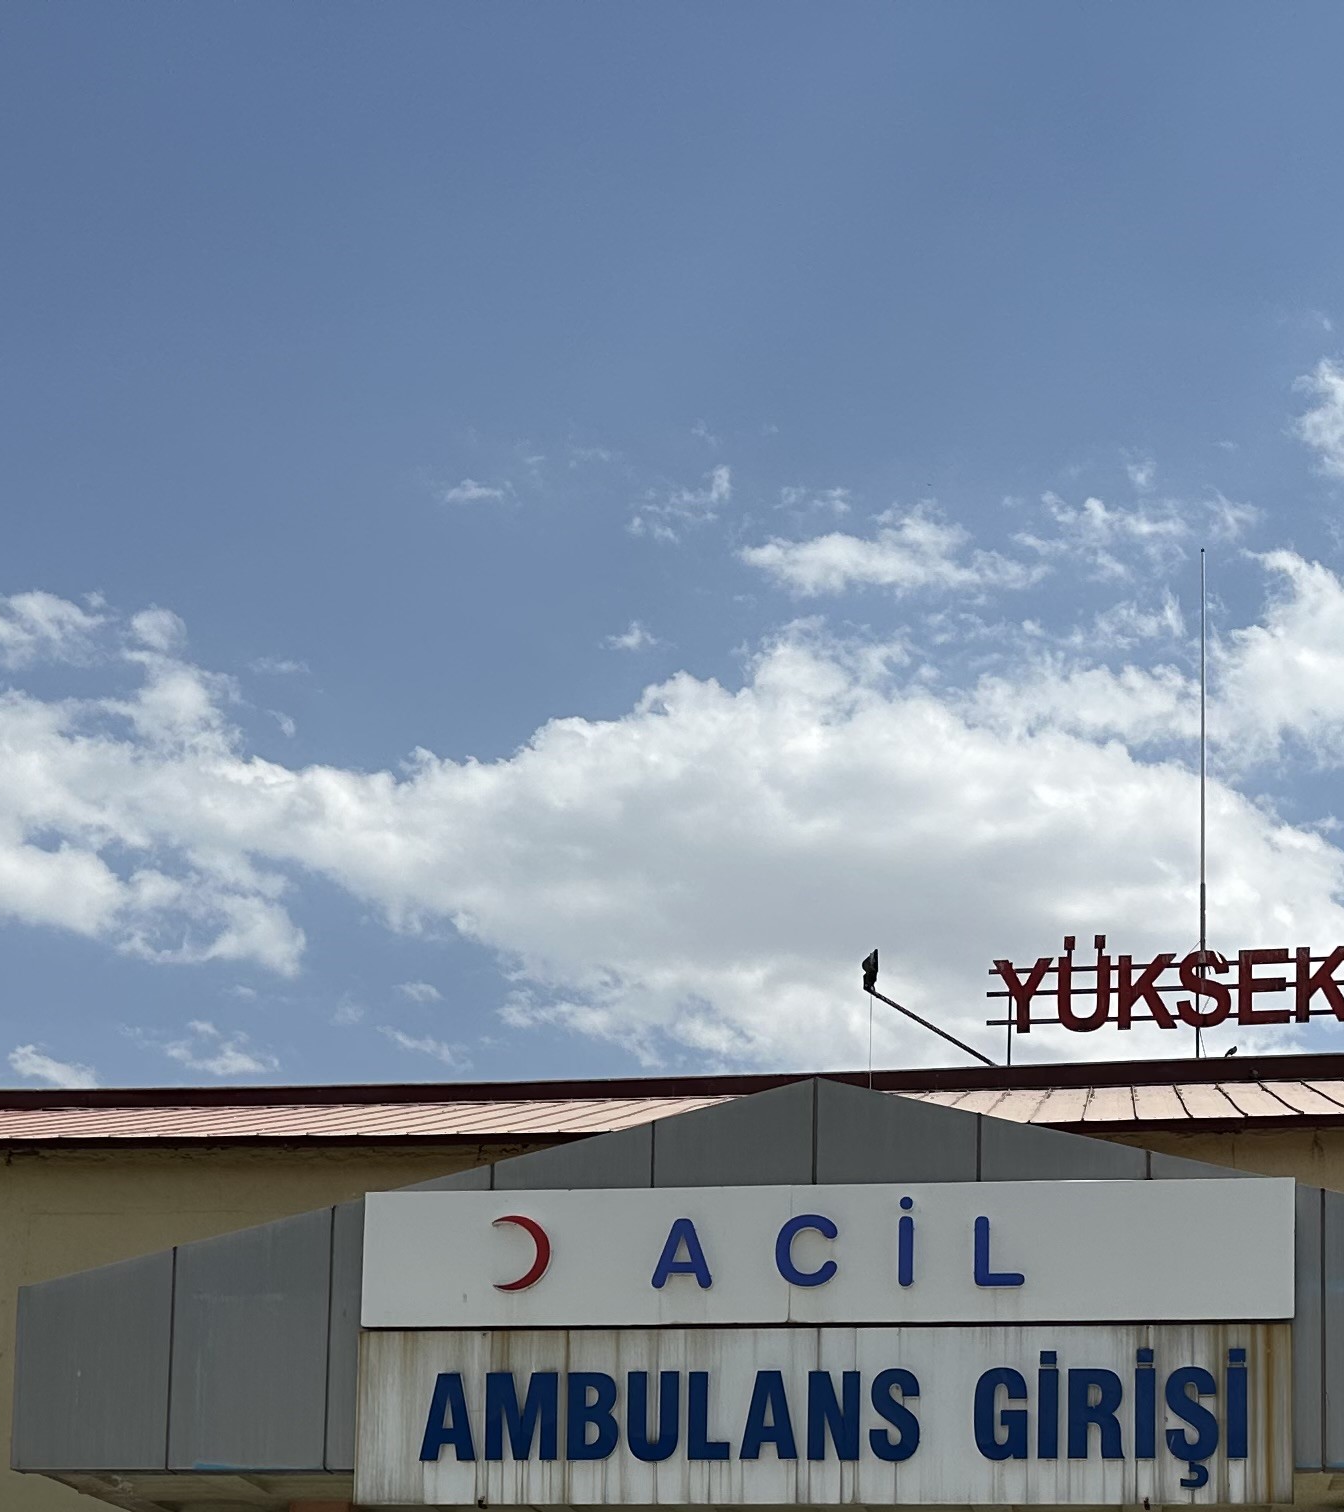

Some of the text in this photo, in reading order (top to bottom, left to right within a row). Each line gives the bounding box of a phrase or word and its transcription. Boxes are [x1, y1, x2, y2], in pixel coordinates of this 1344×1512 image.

[650, 1197, 1025, 1289] ACİL
[419, 1347, 1248, 1488] AMBULANS GİRİŞİ
